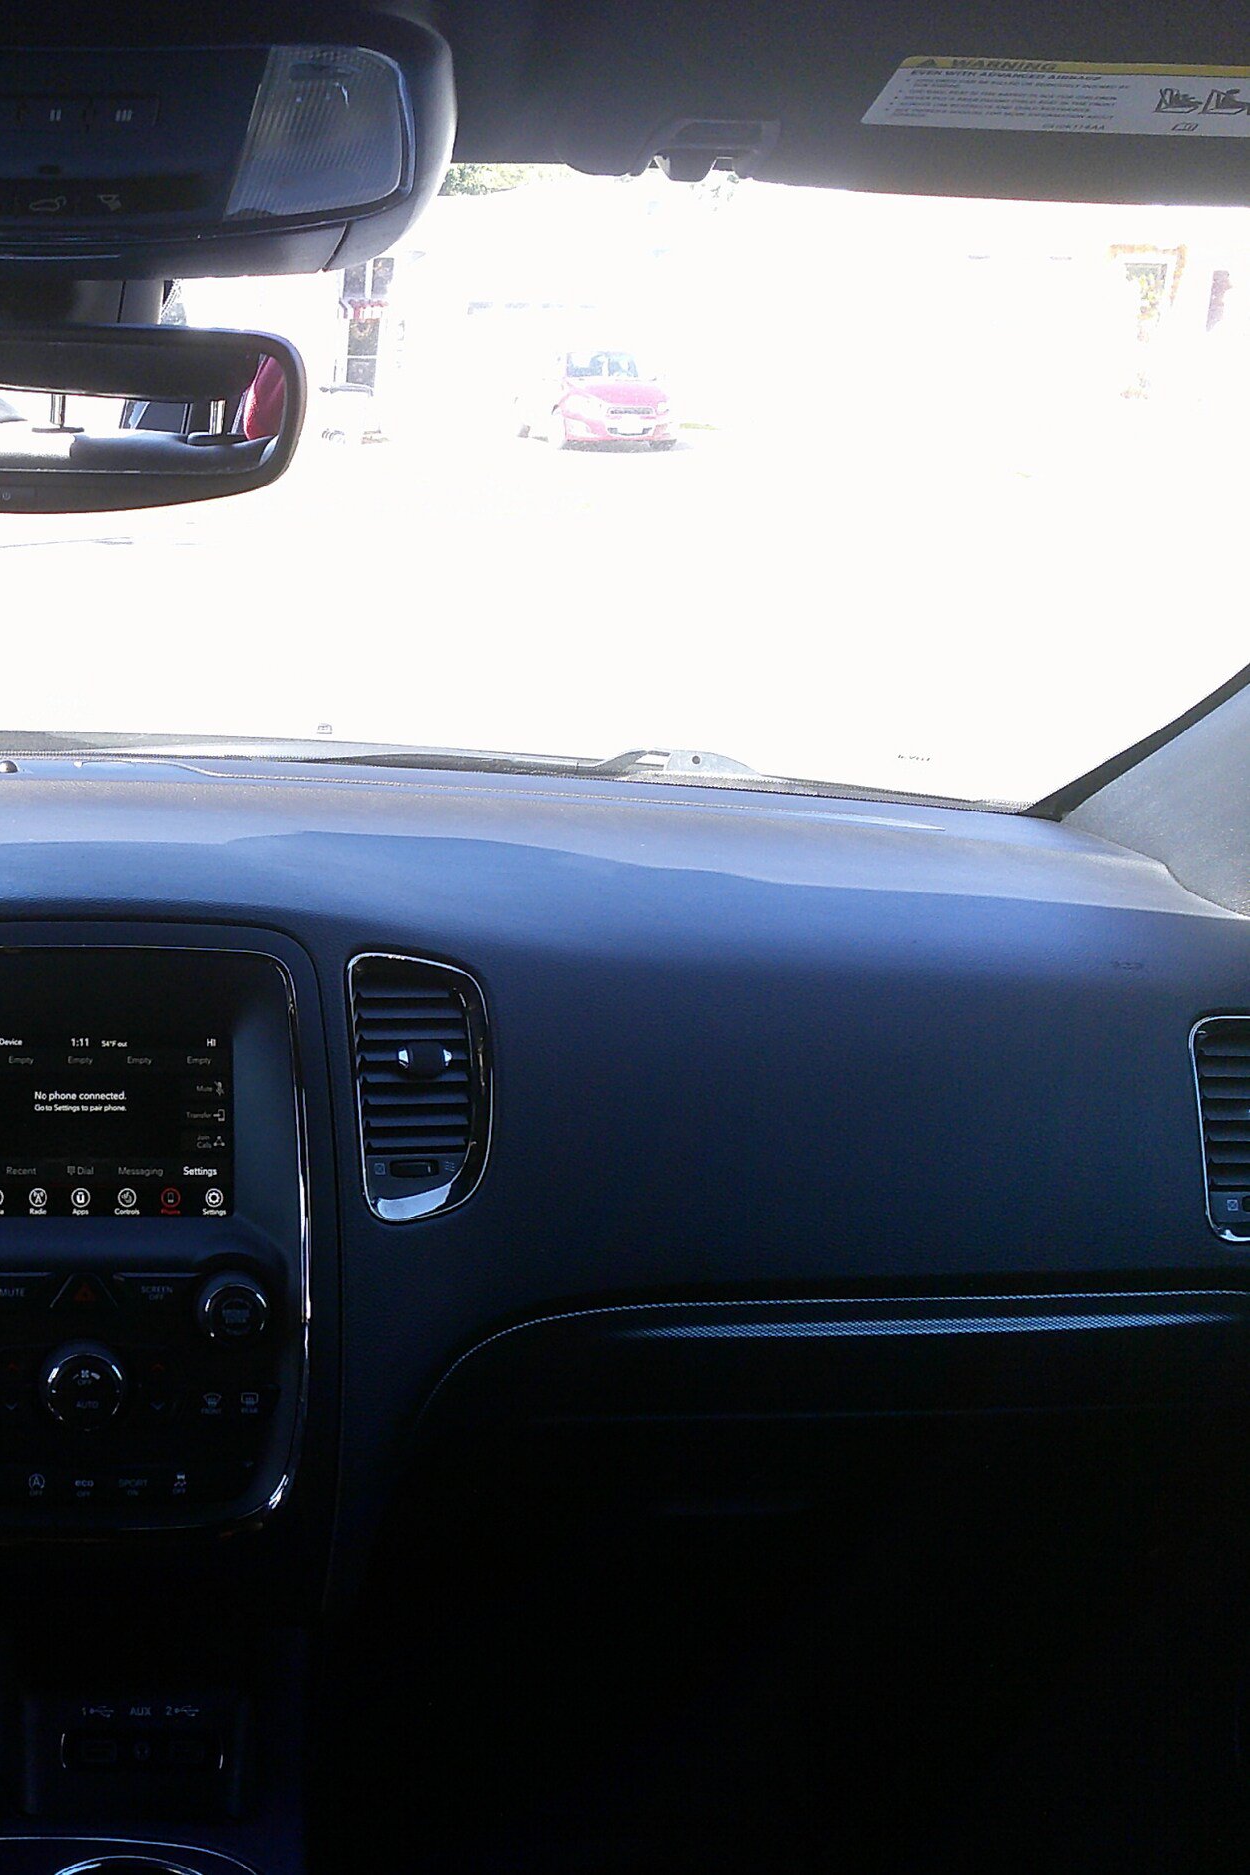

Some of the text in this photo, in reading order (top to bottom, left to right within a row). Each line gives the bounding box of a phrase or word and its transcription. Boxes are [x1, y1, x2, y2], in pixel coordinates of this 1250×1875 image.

[952, 58, 1057, 71] WARNING
[980, 71, 1046, 80] ADVANCED
[70, 1037, 90, 1048] 1:11
[206, 1037, 217, 1047] HI
[8, 1055, 35, 1066] Empty
[67, 1055, 94, 1066] Empty
[126, 1055, 152, 1066] Empty
[186, 1055, 212, 1066] Empty
[34, 1090, 127, 1102] No phone connected.
[53, 1103, 80, 1113] Settings
[81, 1104, 89, 1112] to
[89, 1104, 103, 1113] pair
[103, 1103, 127, 1113] phone.
[6, 1166, 37, 1176] Recent
[77, 1166, 94, 1176] Dial
[118, 1166, 164, 1178] Messaging
[182, 1165, 218, 1178] Settings
[29, 1207, 48, 1215] Radio
[71, 1208, 90, 1216] Apps
[114, 1207, 141, 1216] Controls
[202, 1207, 227, 1217] Settings
[129, 1706, 152, 1717] AUX
